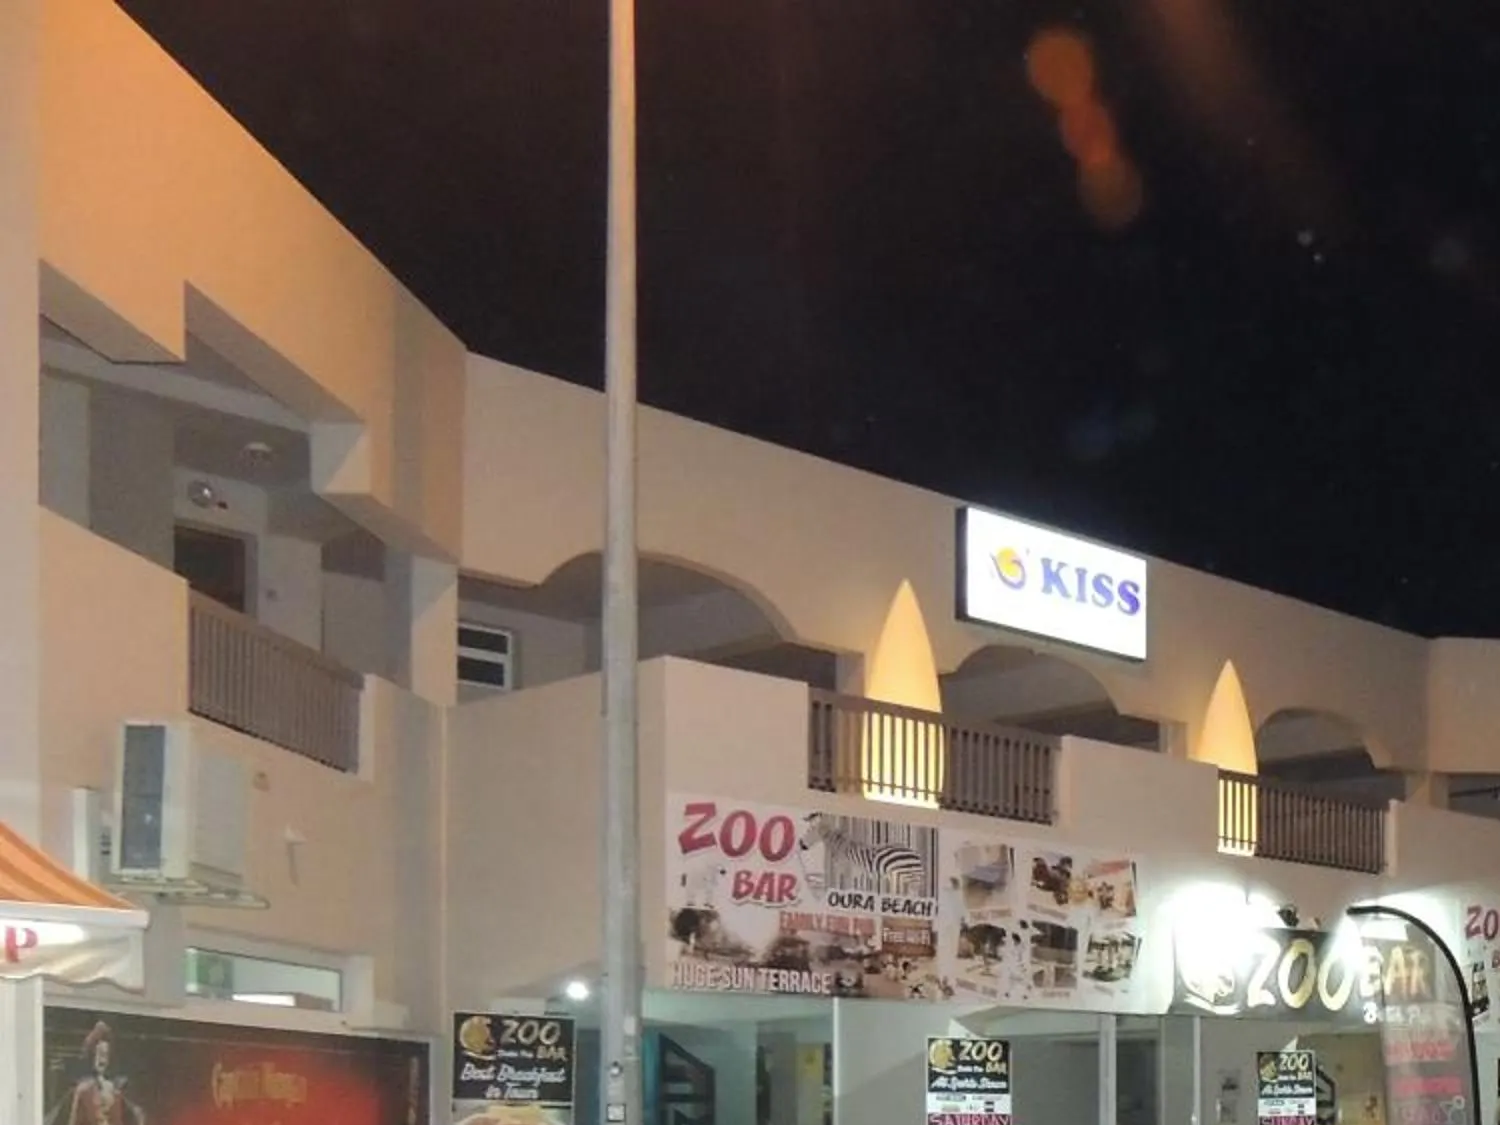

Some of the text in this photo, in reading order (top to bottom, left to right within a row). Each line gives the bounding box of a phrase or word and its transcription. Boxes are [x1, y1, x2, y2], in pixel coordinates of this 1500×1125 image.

[1040, 557, 1141, 617] KISS
[678, 802, 796, 863] ZOO
[731, 870, 799, 904] BAR
[827, 890, 934, 918] OURA BEACH
[673, 961, 832, 995] HUGE SUN TERRACE
[1247, 938, 1355, 1012] ZOO
[500, 1019, 560, 1046] ZOO
[958, 1040, 1003, 1062] ZOO
[1279, 1053, 1309, 1072] ZOO
